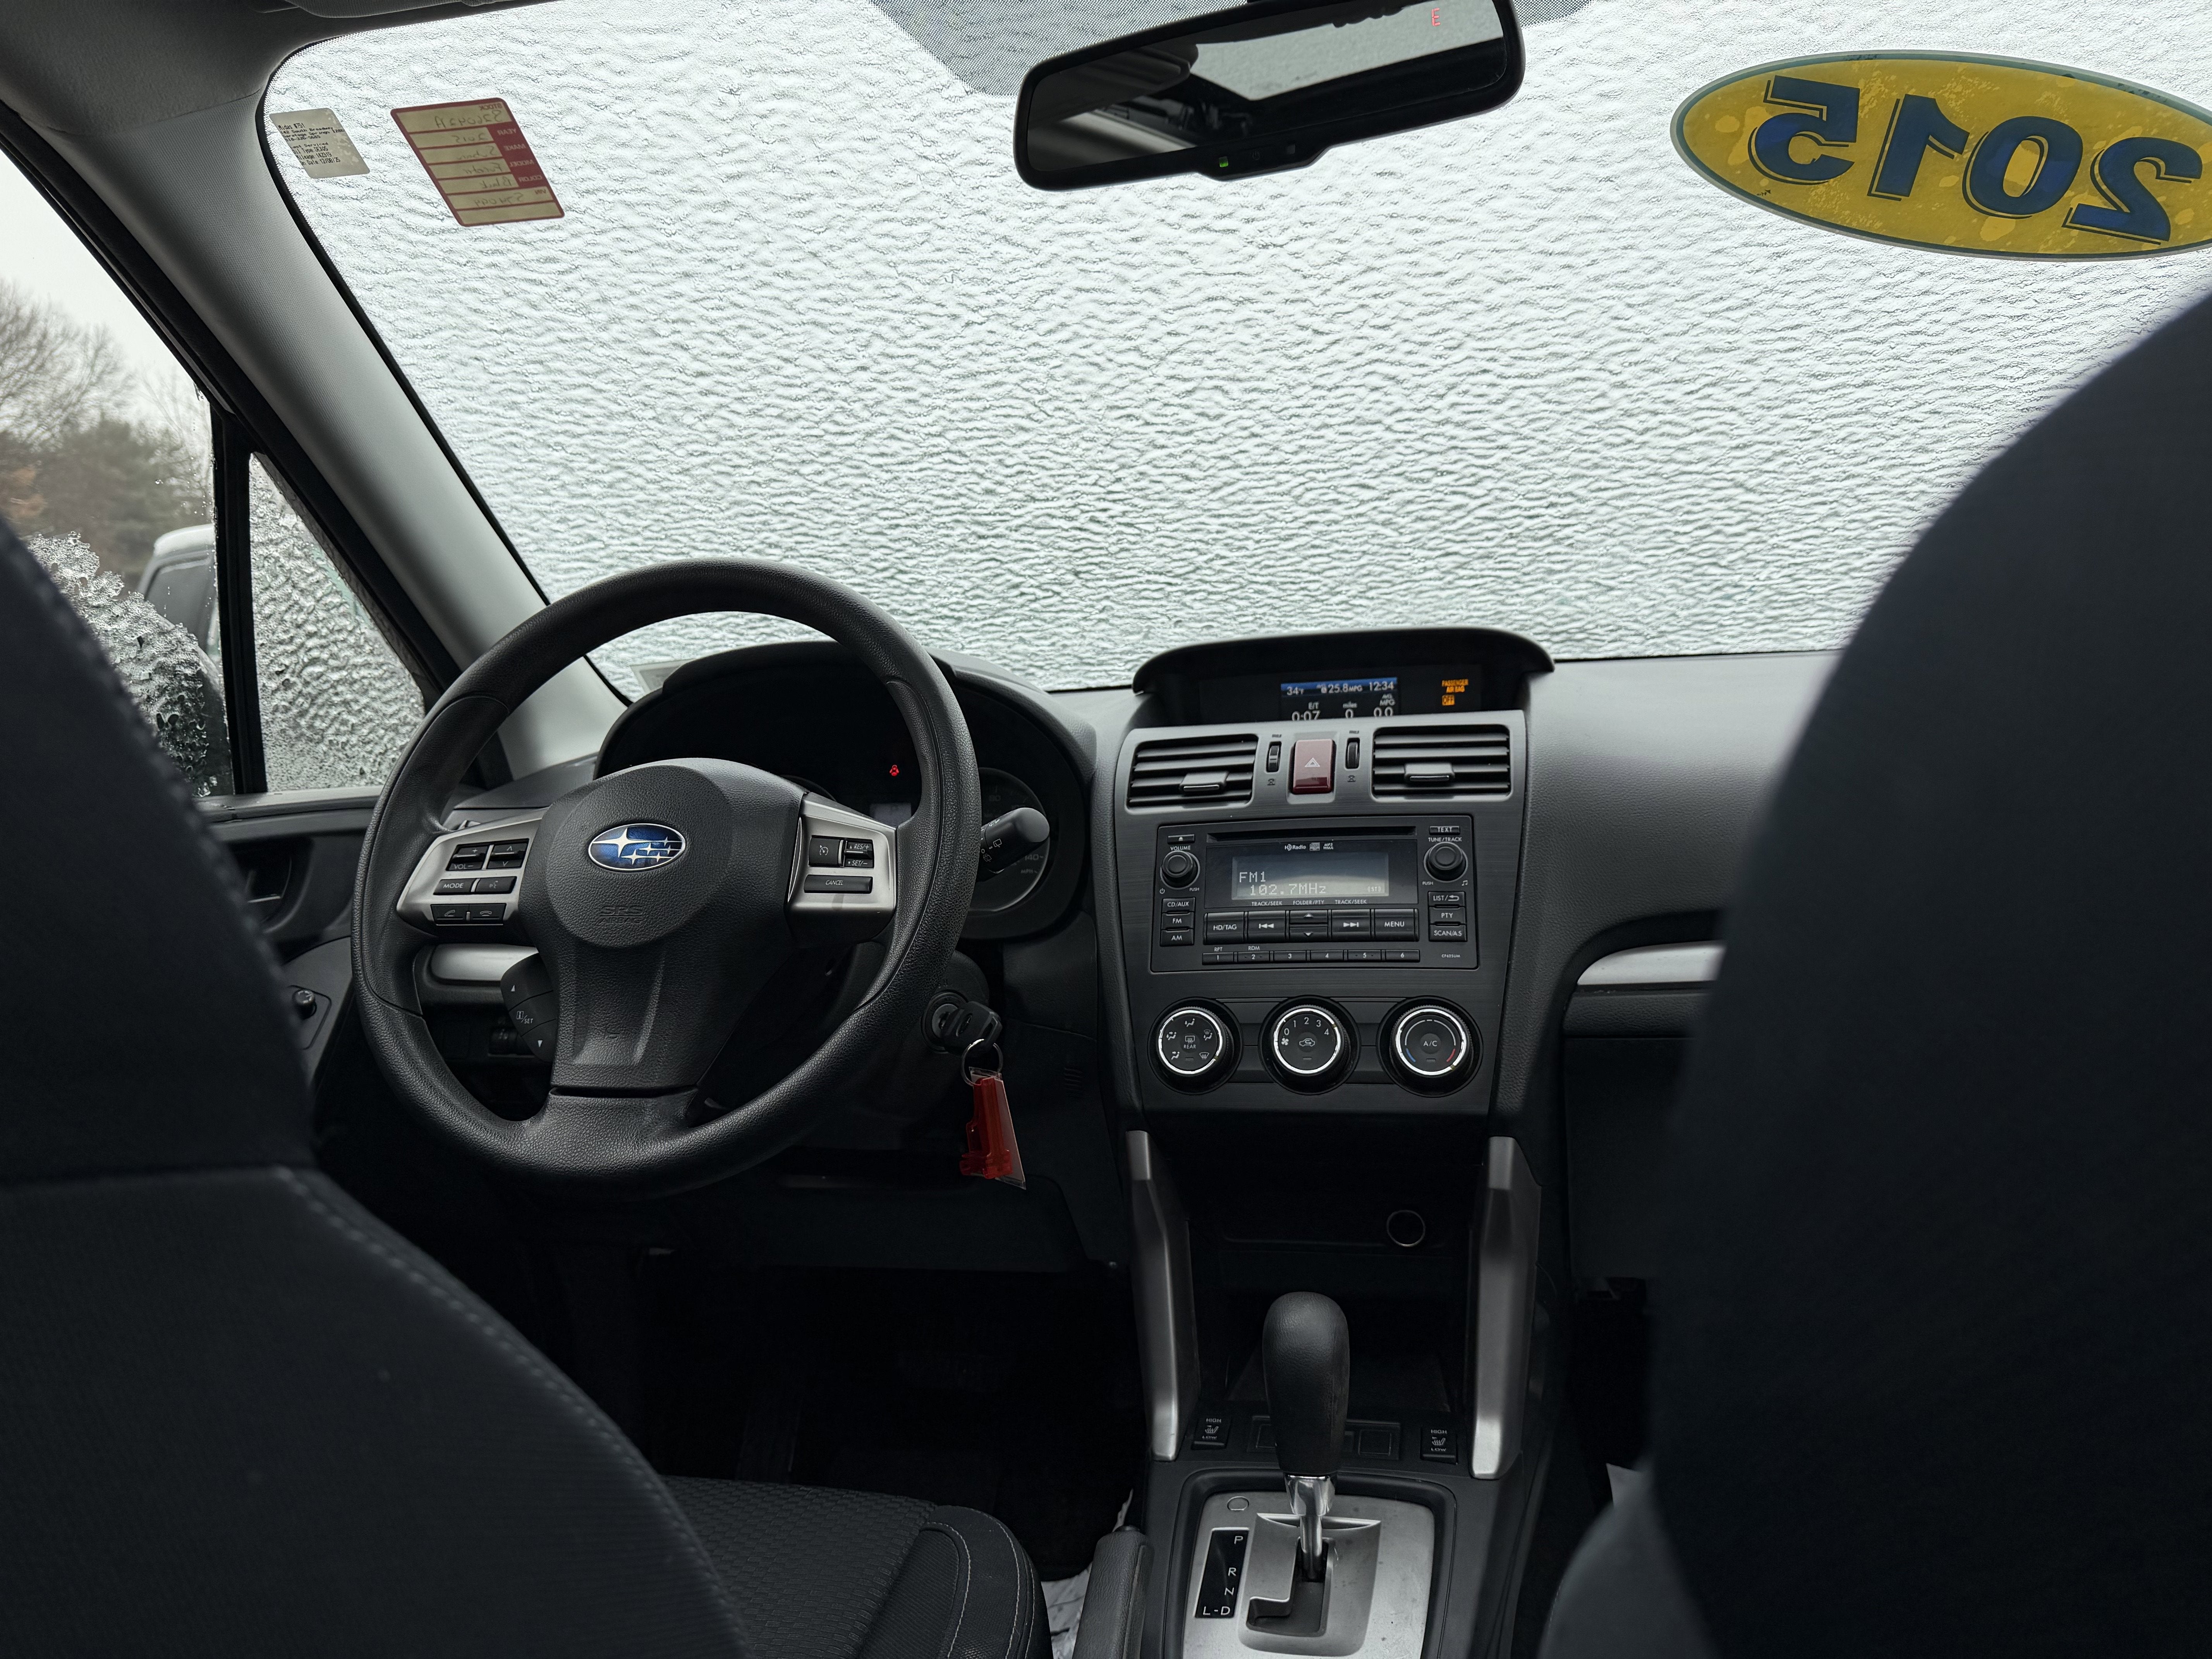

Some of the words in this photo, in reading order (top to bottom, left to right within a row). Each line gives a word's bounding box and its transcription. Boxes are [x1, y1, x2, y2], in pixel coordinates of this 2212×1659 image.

[1370, 681, 1395, 691] 12:34
[1443, 696, 1453, 704] OFF
[1239, 872, 1266, 882] FM1
[1250, 884, 1326, 896] 102.7MHz
[600, 905, 643, 915] SRS
[1234, 1535, 1243, 1544] P
[1228, 1568, 1237, 1577] R
[1224, 1587, 1234, 1596] N
